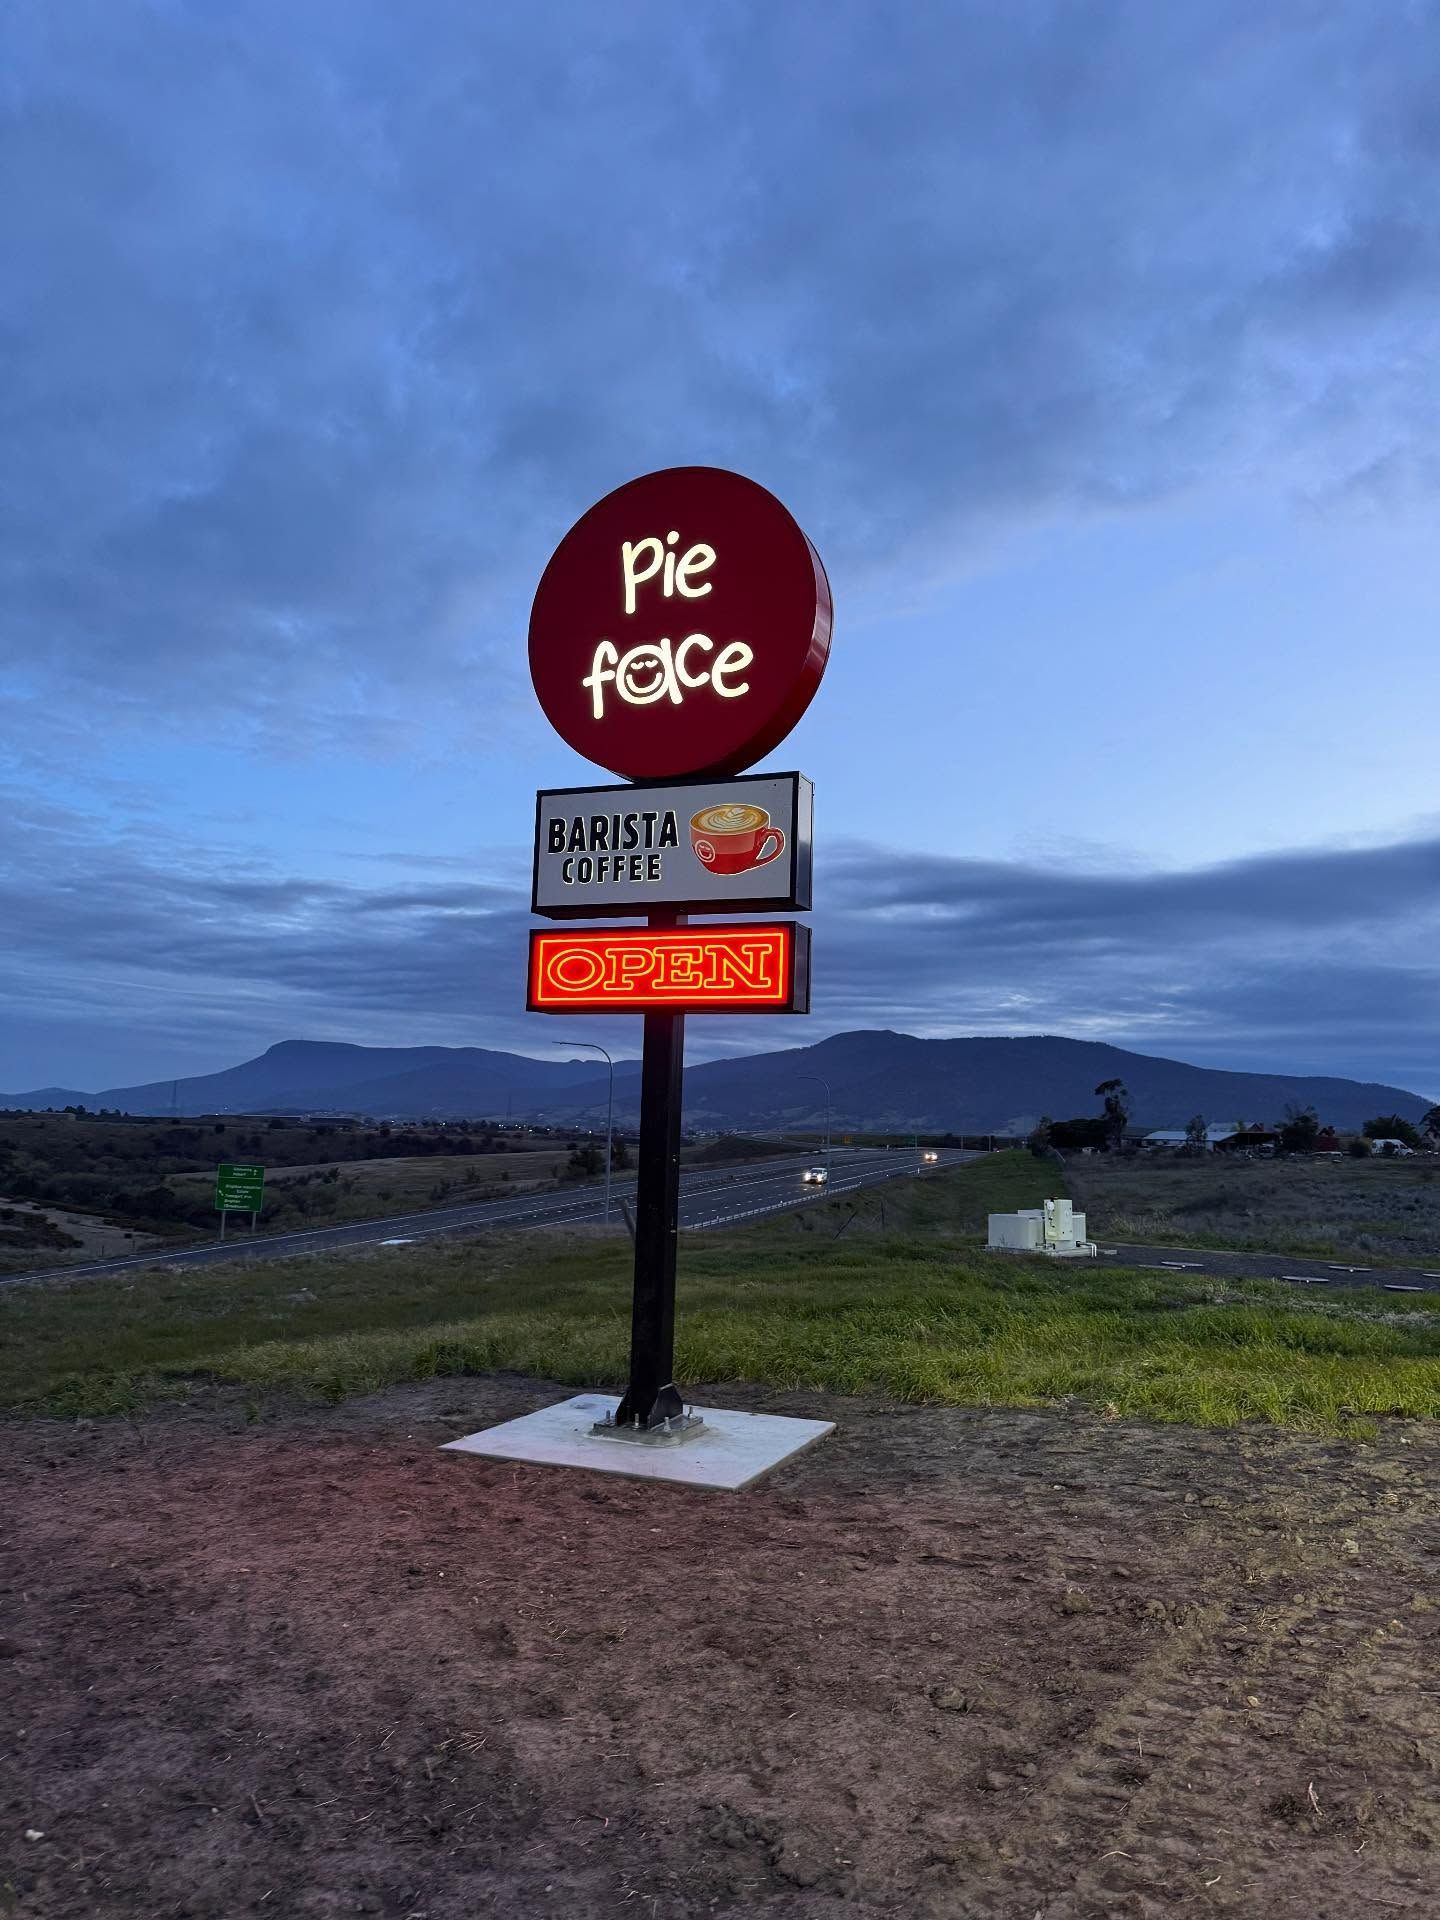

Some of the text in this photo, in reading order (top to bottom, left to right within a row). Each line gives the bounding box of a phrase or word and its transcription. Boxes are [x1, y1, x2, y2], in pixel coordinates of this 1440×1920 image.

[622, 531, 717, 615] pie
[582, 633, 754, 720] face
[548, 810, 680, 854] BARISTA
[562, 854, 662, 885] COFFEE
[547, 944, 773, 992] OPEN
